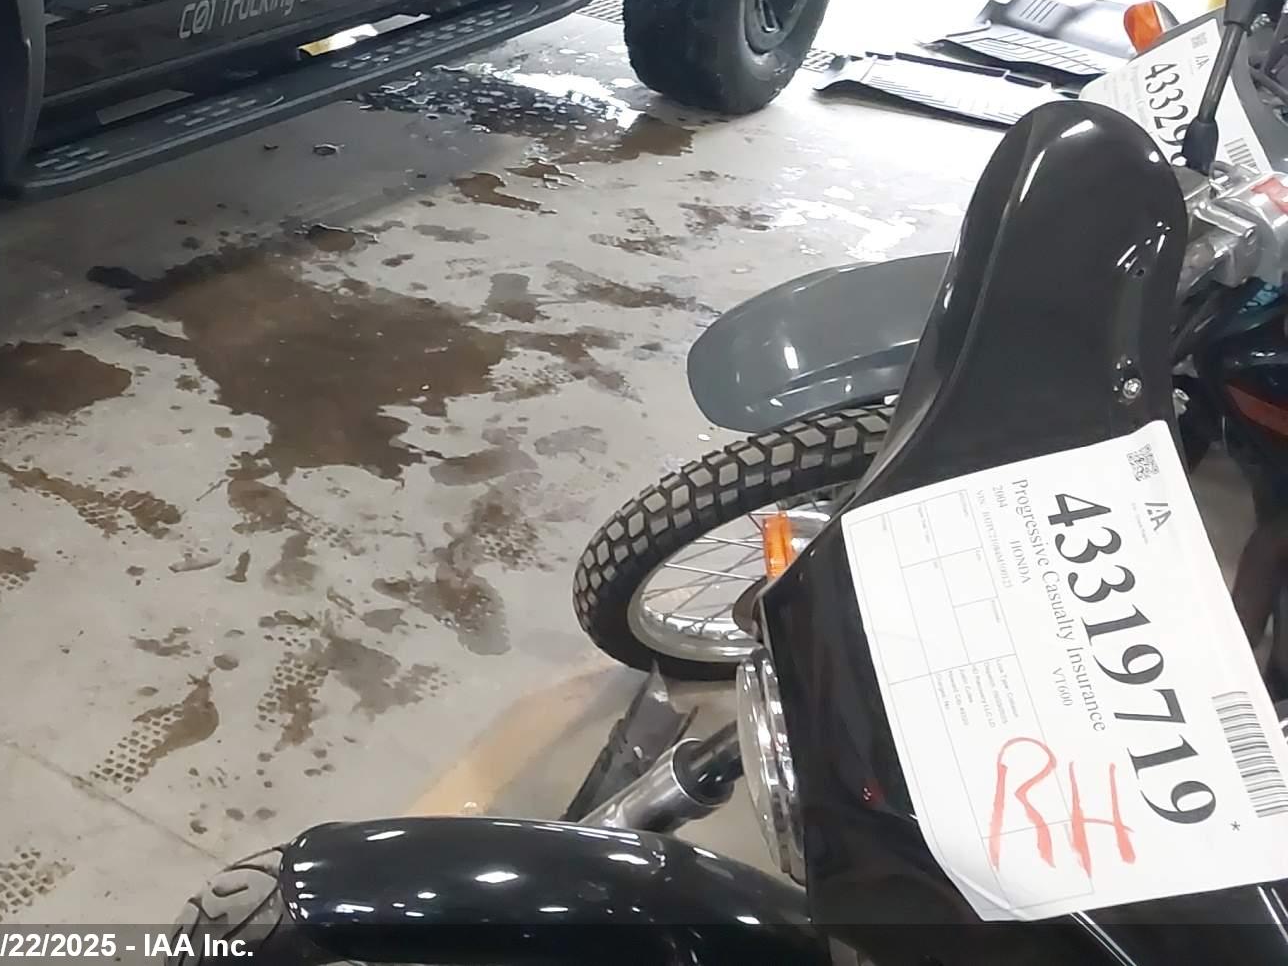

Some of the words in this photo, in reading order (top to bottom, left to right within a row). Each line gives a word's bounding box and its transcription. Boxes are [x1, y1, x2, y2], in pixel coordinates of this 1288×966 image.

[992, 484, 1009, 508] 2004
[1009, 540, 1032, 584] HONDA
[1052, 667, 1073, 707] VT600
[1011, 479, 1050, 567] Progressive
[1041, 570, 1075, 640] Casualty
[1066, 646, 1106, 731] Insurance
[1048, 492, 1217, 825] 43319719
[988, 736, 1136, 880] RH
